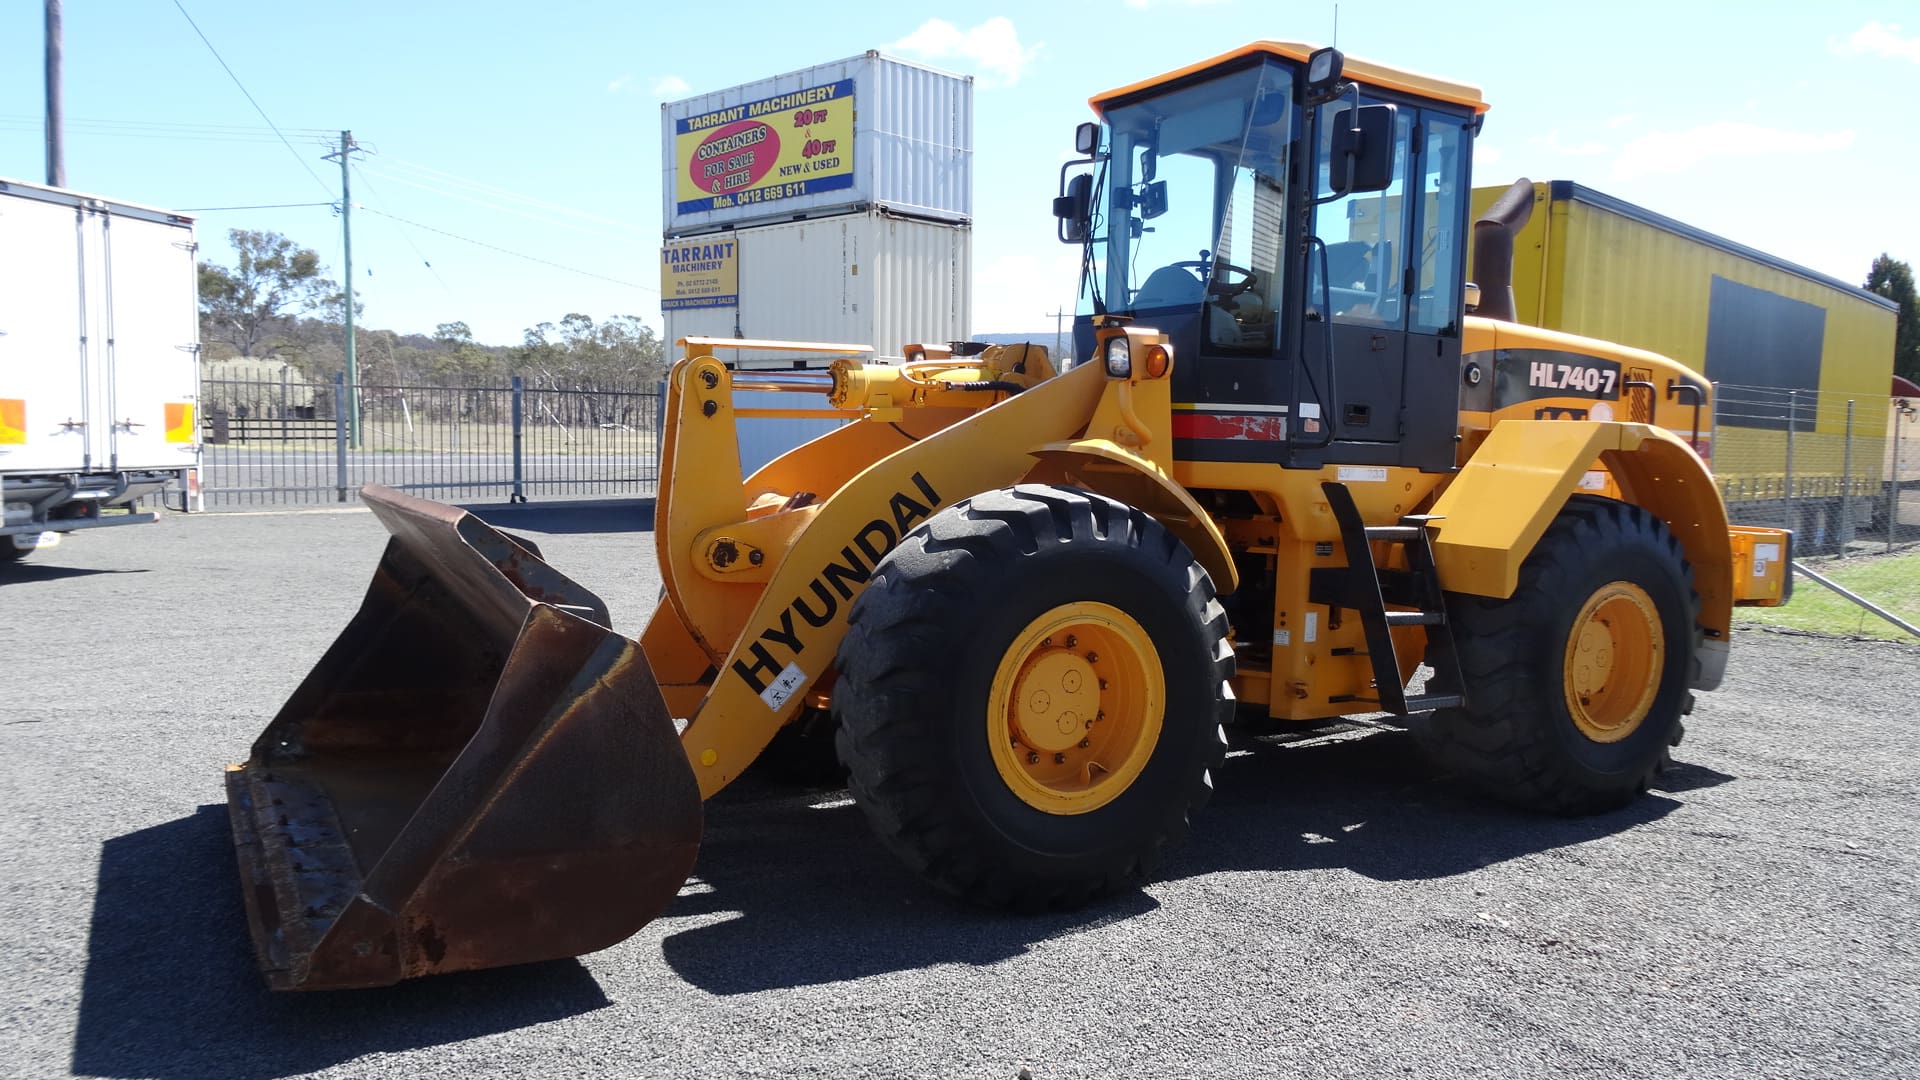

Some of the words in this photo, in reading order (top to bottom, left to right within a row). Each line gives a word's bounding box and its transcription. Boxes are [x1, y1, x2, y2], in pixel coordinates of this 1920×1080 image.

[688, 106, 745, 131] TARRANT
[750, 85, 836, 116] MACHINERY
[698, 125, 767, 160] CONTAINERS
[804, 128, 812, 139] &
[704, 161, 725, 179] FOR
[728, 151, 755, 171] SALE
[779, 164, 802, 177] NEW
[803, 162, 811, 174] &
[813, 157, 840, 171] USED
[711, 179, 721, 193] &
[724, 171, 751, 189] HIRE
[713, 194, 735, 209] Mob.
[737, 190, 761, 205] 0412
[764, 186, 784, 199] 669
[786, 182, 806, 196] 611
[663, 243, 734, 264] TARRANT
[672, 261, 723, 273] MACHINERY
[1529, 361, 1617, 394] HL740-7
[731, 471, 942, 696] HYUNDAI
